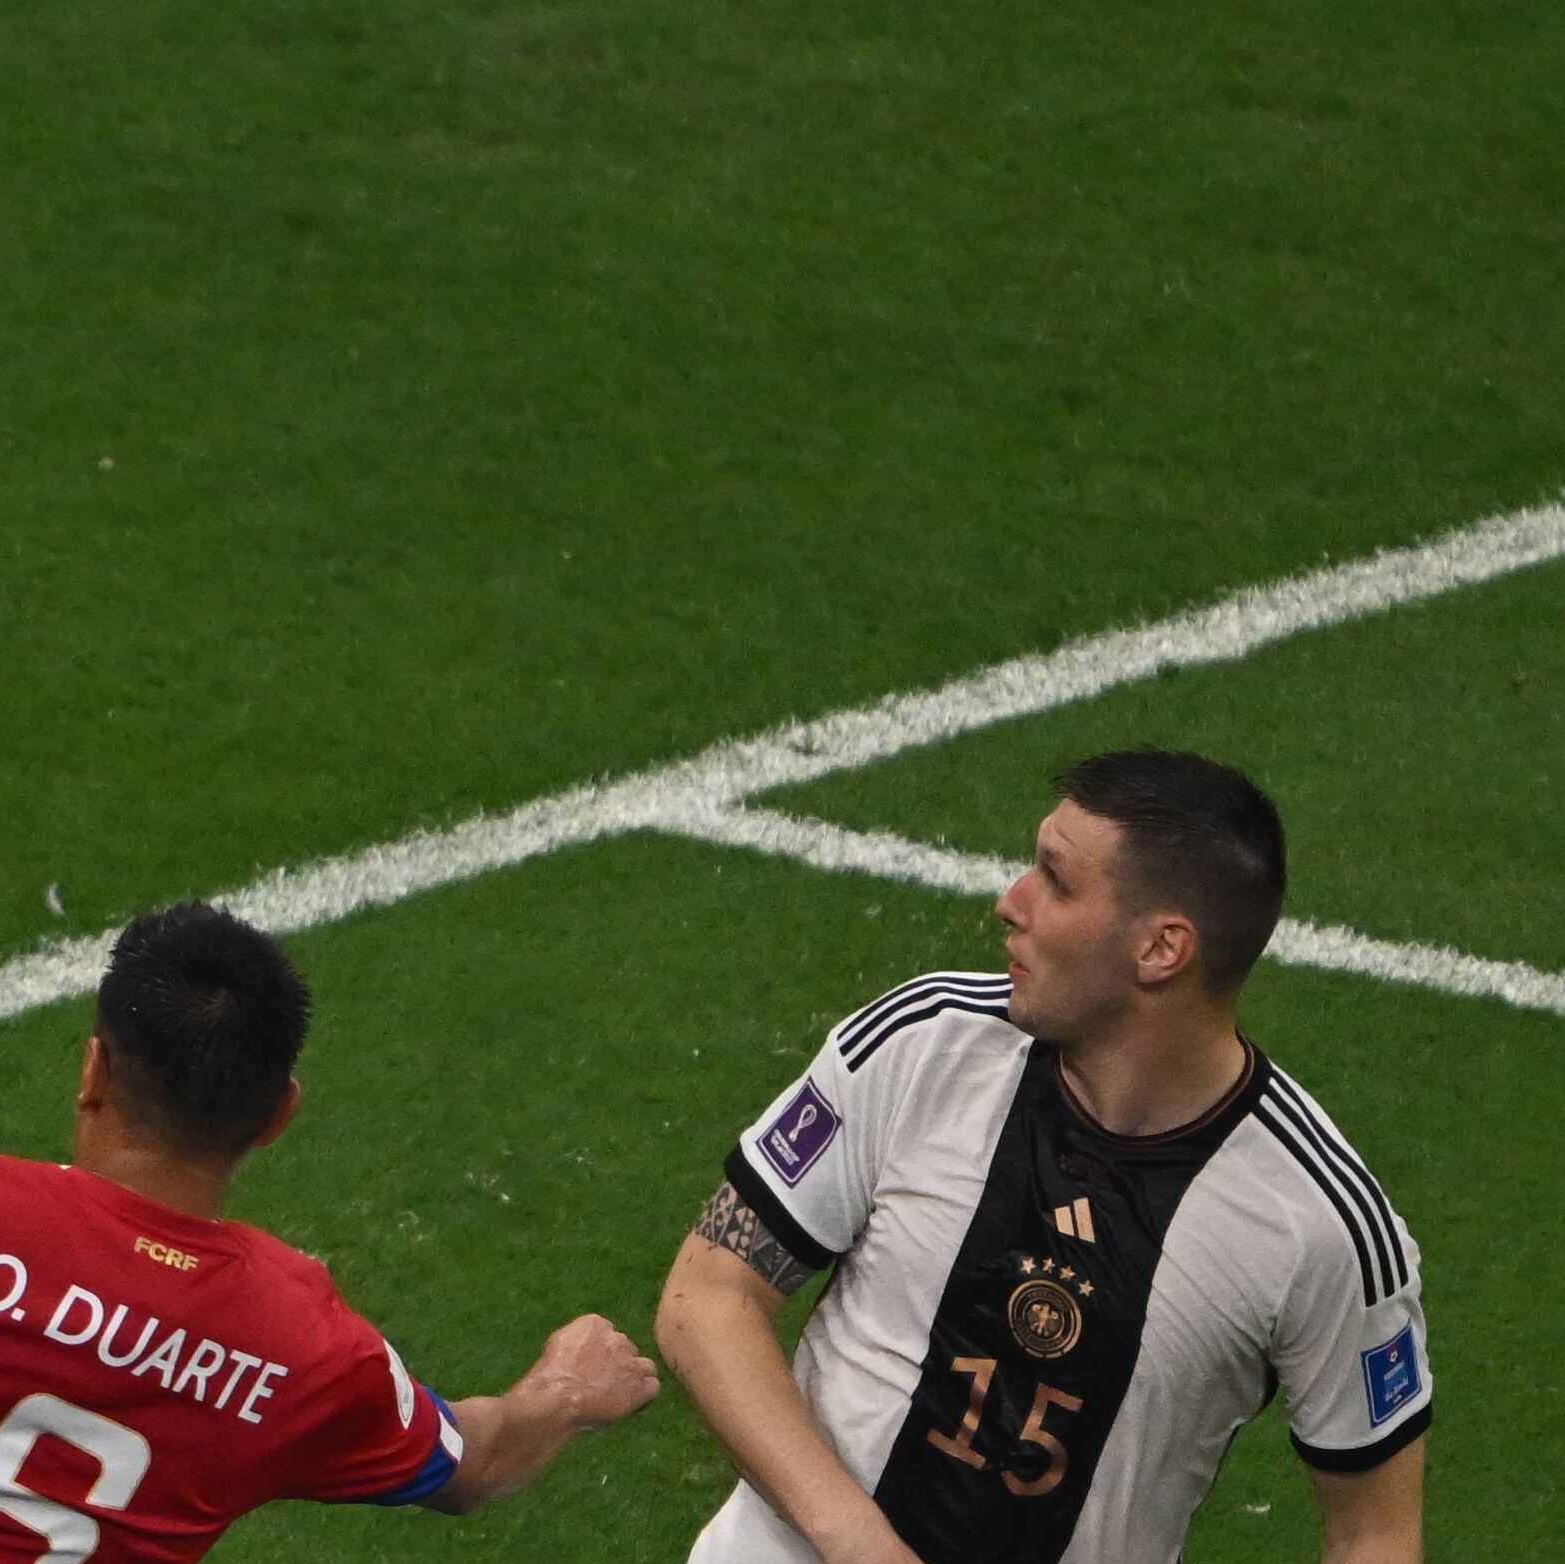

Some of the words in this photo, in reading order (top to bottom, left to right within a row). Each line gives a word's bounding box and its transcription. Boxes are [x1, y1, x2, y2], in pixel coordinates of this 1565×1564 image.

[133, 1236, 199, 1271] FCRF
[44, 1284, 288, 1424] DUARTE
[927, 1357, 1084, 1496] 15
